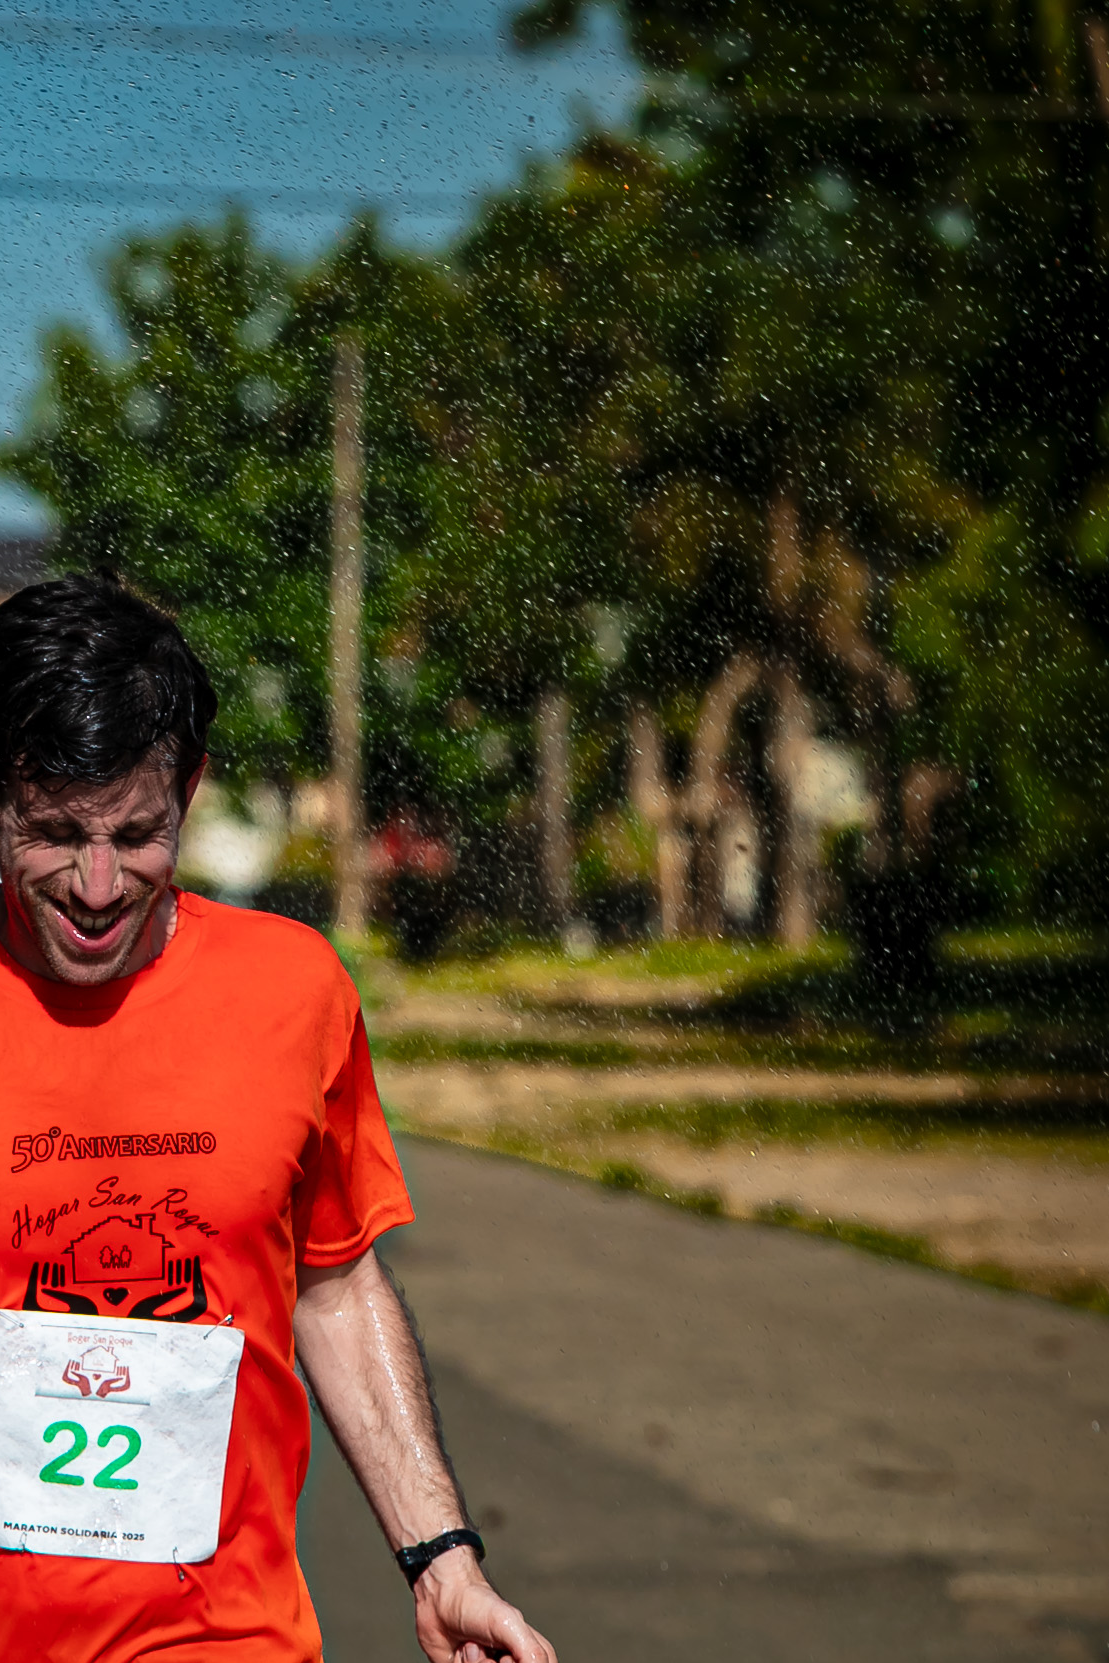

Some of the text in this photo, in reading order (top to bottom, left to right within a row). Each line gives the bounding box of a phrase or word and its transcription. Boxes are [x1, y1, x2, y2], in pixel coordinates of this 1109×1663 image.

[58, 1132, 217, 1160] ANIVERSARIO
[11, 1176, 220, 1249] Hogar San Roque
[39, 1420, 142, 1490] 22
[3, 1521, 58, 1534] MARATON
